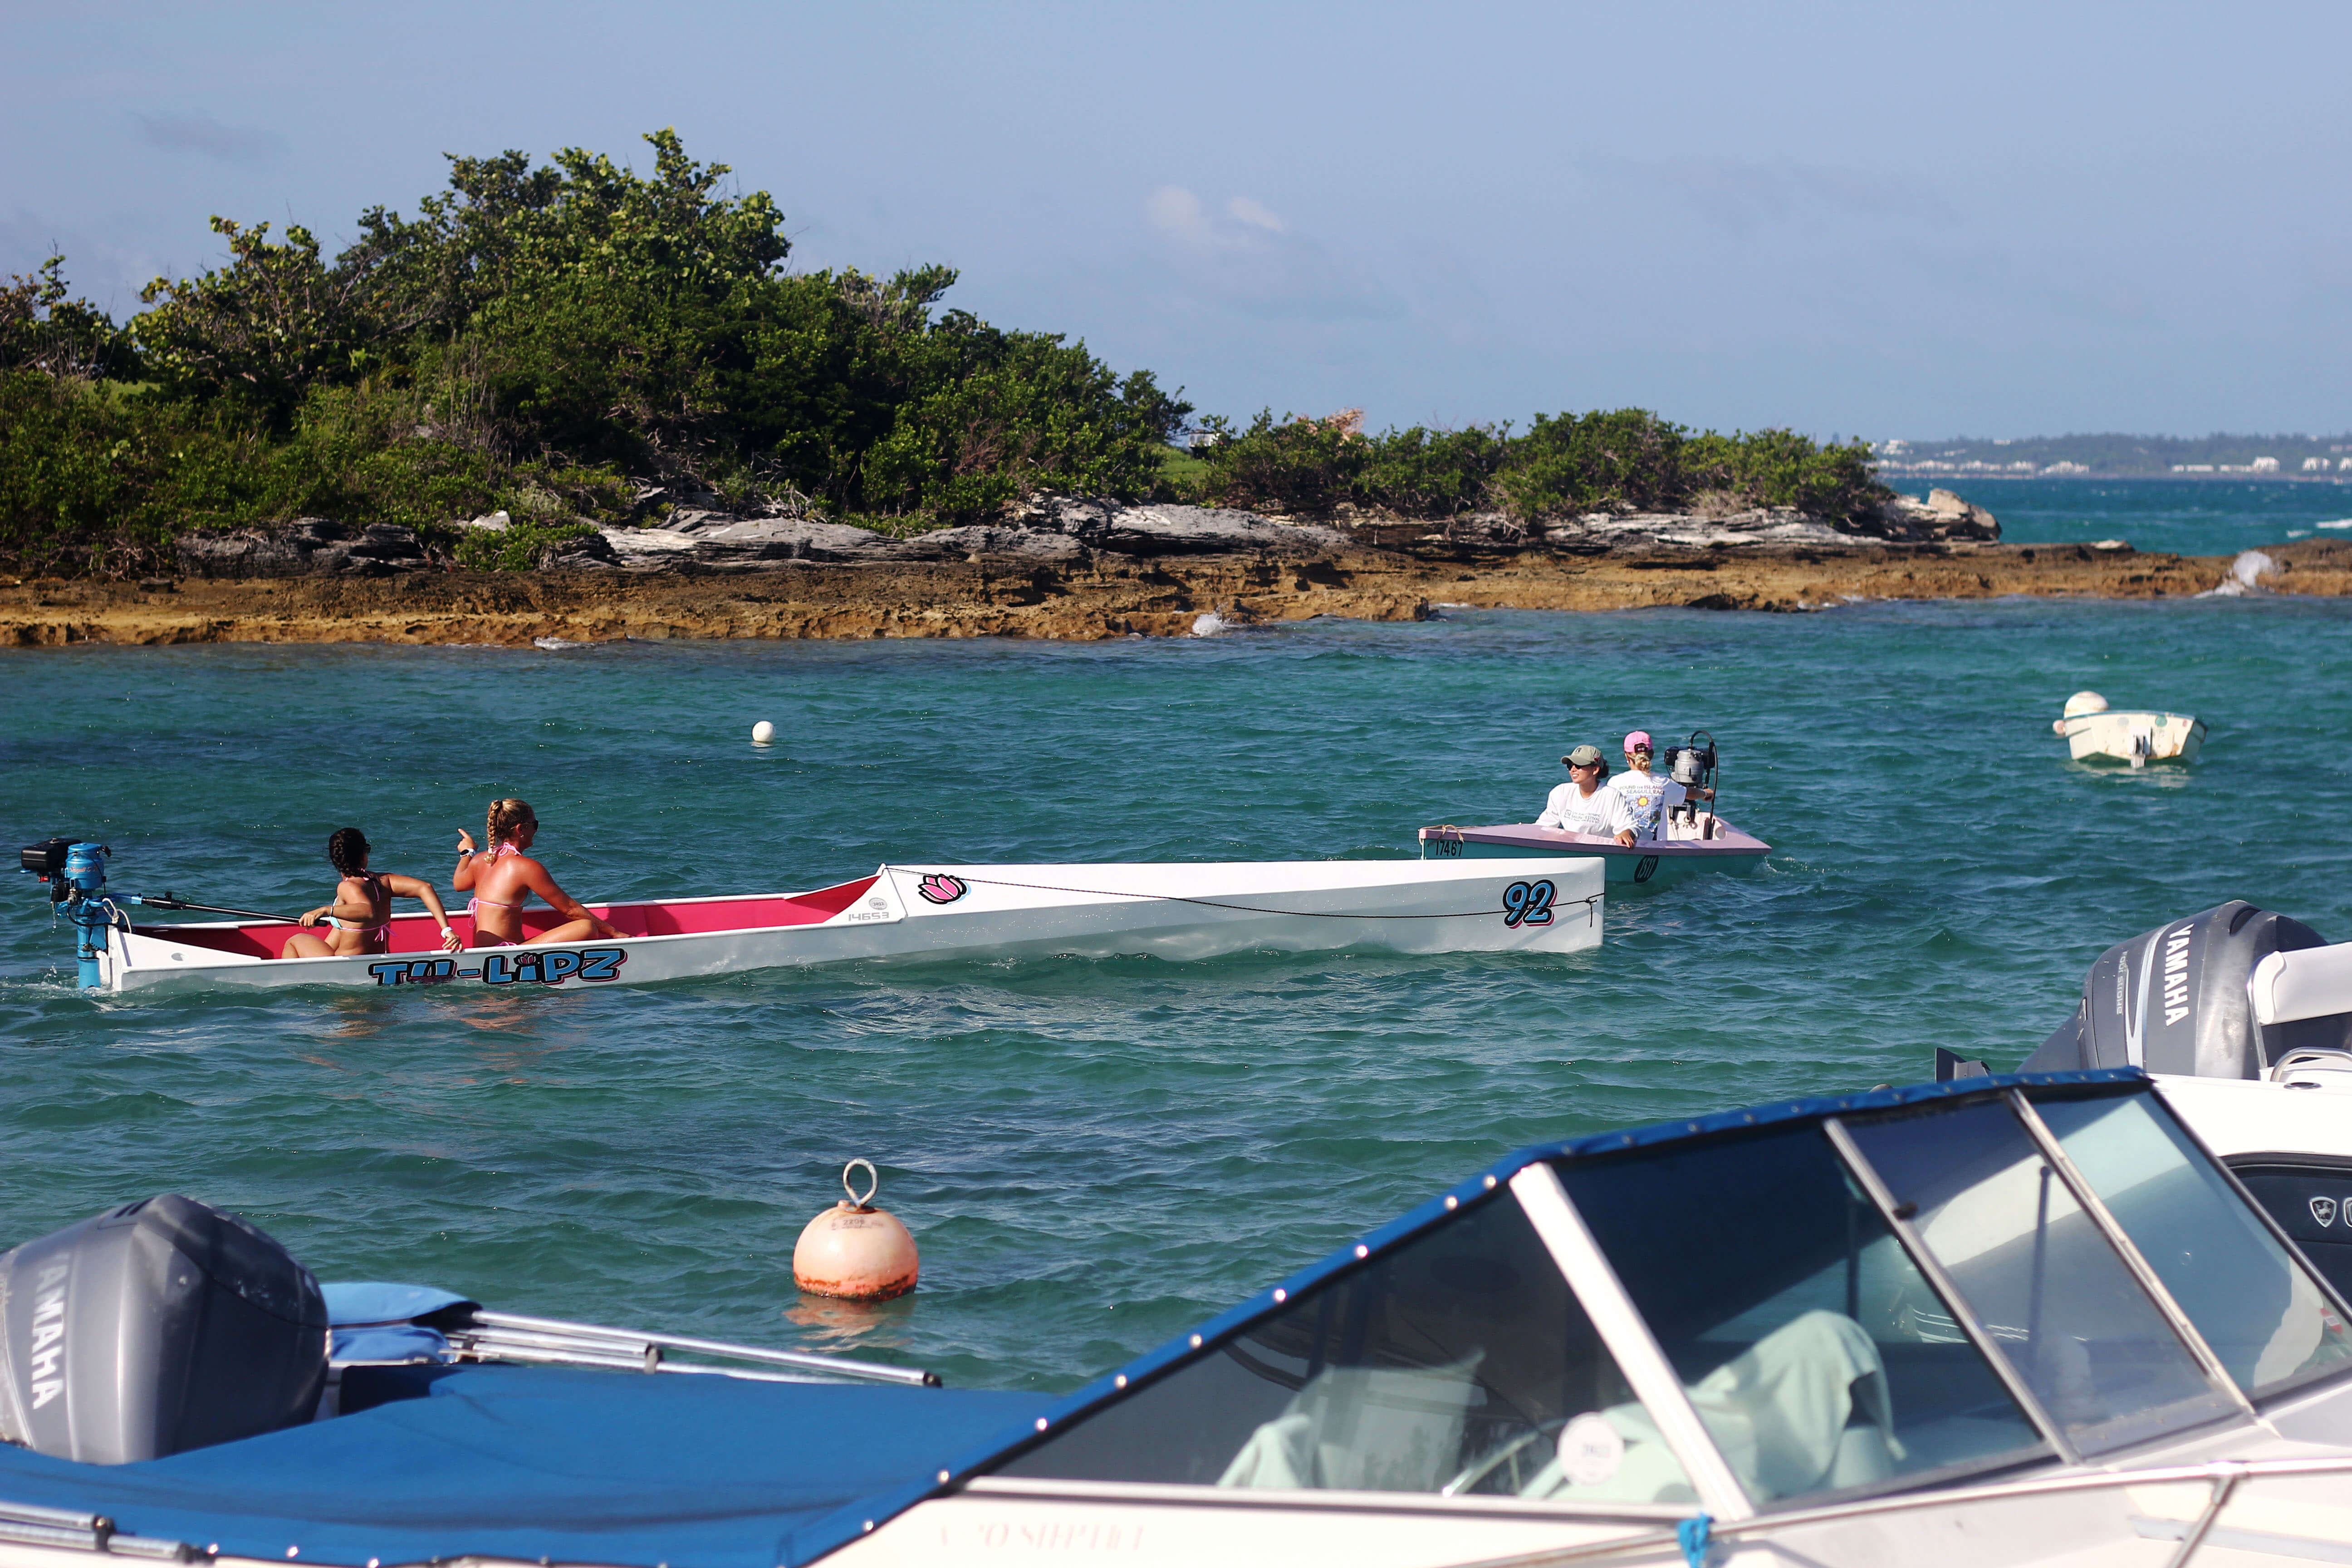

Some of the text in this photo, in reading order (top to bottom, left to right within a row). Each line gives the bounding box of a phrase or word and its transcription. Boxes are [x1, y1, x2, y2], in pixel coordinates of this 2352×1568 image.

[1436, 840, 1463, 857] 17467
[1637, 857, 1657, 878] 1511
[1503, 879, 1557, 929] 92
[848, 911, 889, 921] 14653
[2164, 923, 2195, 1027] YAMAHA
